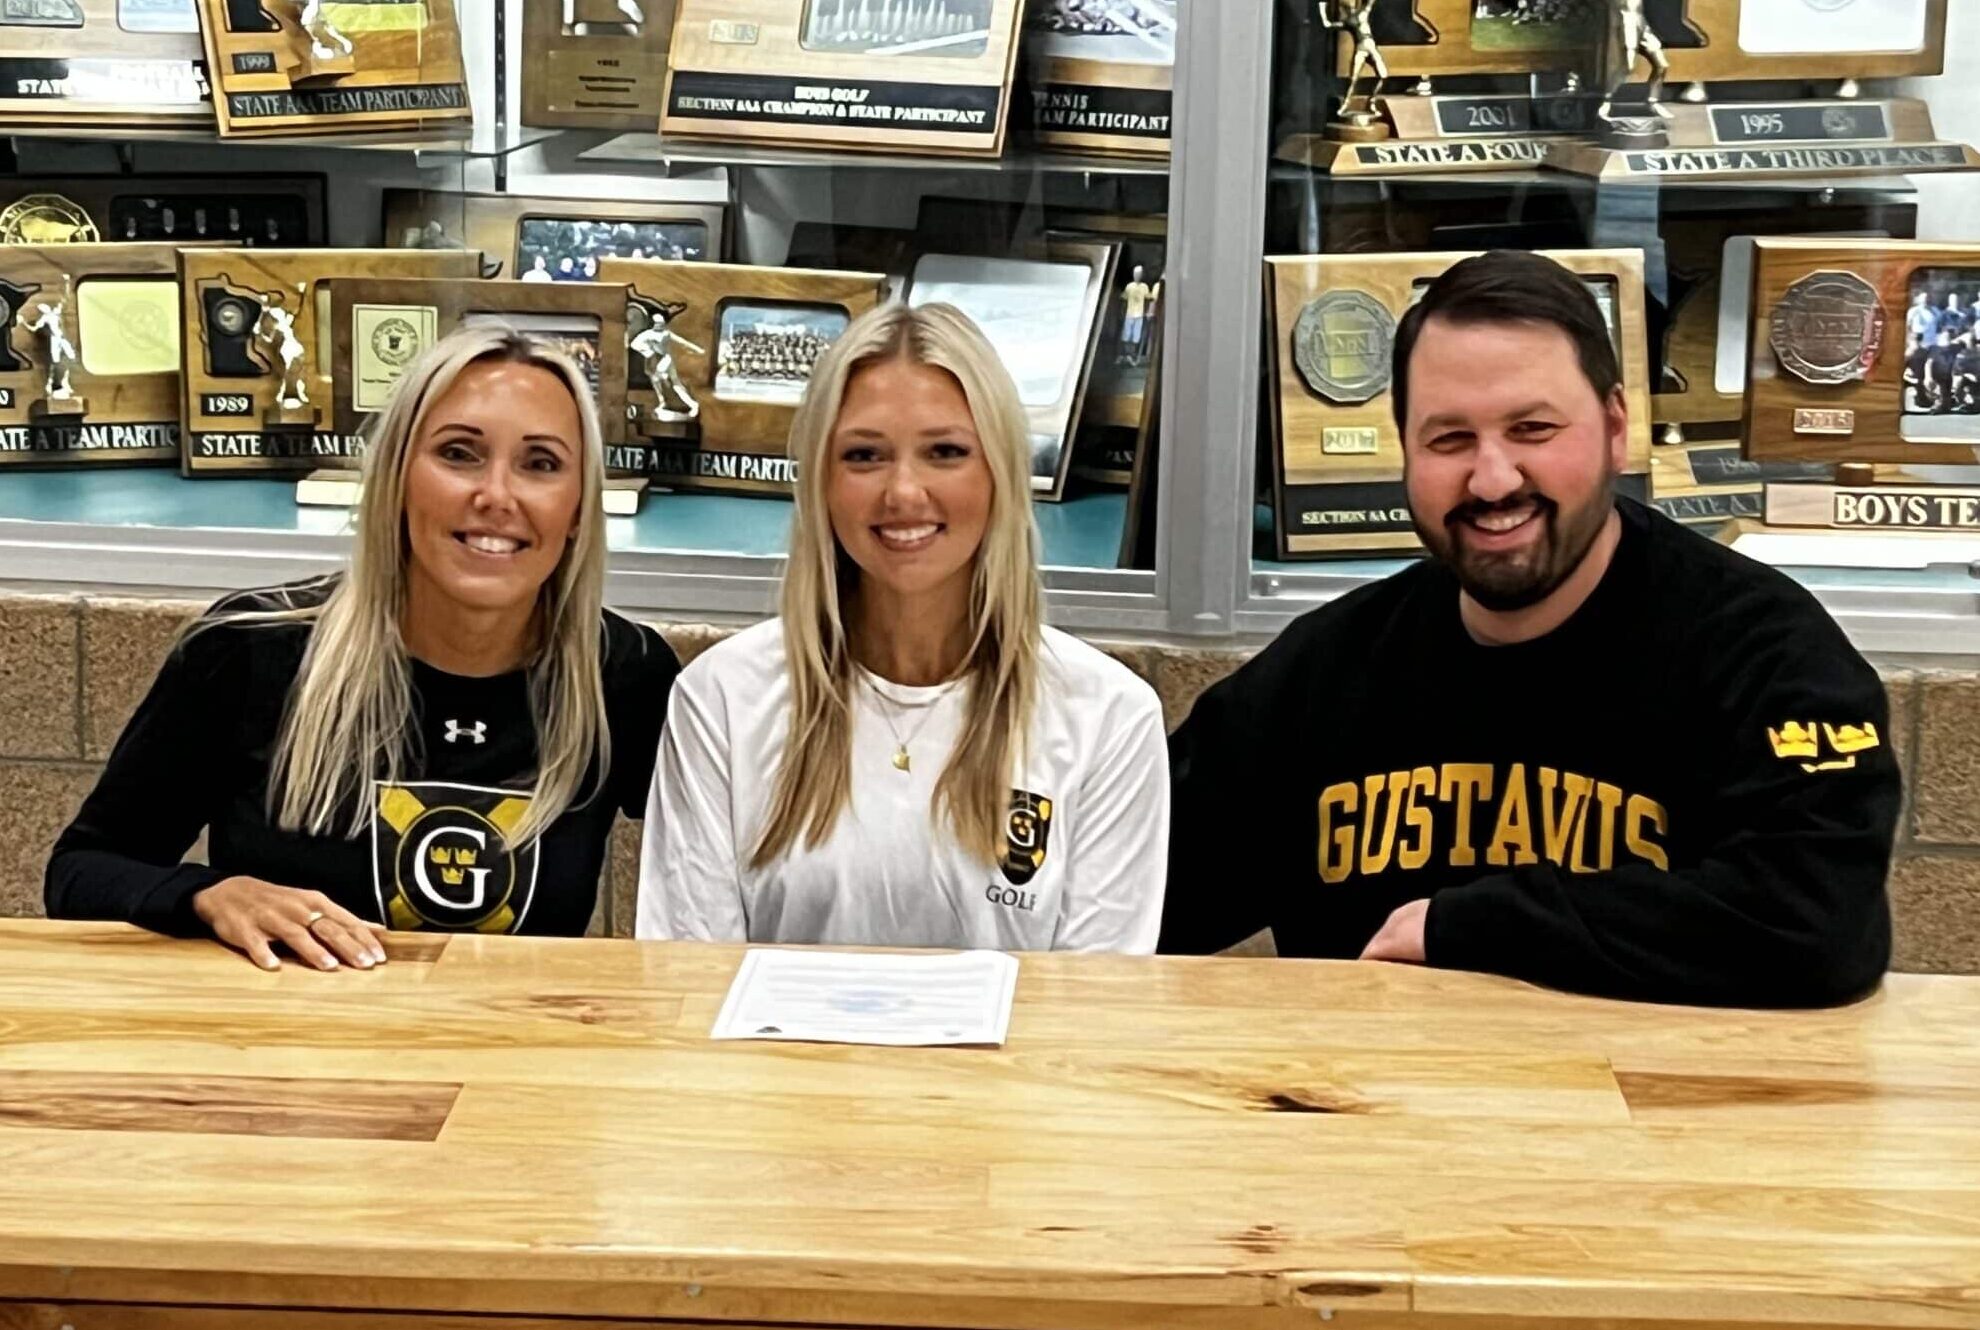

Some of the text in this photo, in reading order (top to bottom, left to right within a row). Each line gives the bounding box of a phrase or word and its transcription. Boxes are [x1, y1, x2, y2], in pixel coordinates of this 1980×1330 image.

[234, 94, 285, 117] STATE
[319, 90, 362, 113] TEAM
[364, 86, 466, 110] PARTICIPANT
[894, 107, 986, 124] PARTICIPANT
[1068, 112, 1169, 130] PARTICIPANT
[1466, 106, 1517, 127] 2001
[1740, 114, 1783, 135] 1995
[1375, 144, 1454, 164] STATE
[1643, 154, 1731, 172] STATE
[1739, 152, 1755, 169] A
[1765, 150, 1857, 169] THIRD
[207, 396, 249, 413] 1989
[55, 425, 109, 450] TEAM
[201, 434, 262, 456] STATE
[691, 452, 738, 478] TEAM
[1836, 494, 1928, 525] BOYS
[1318, 762, 1669, 884] GUSTAVUS
[414, 826, 492, 909] G
